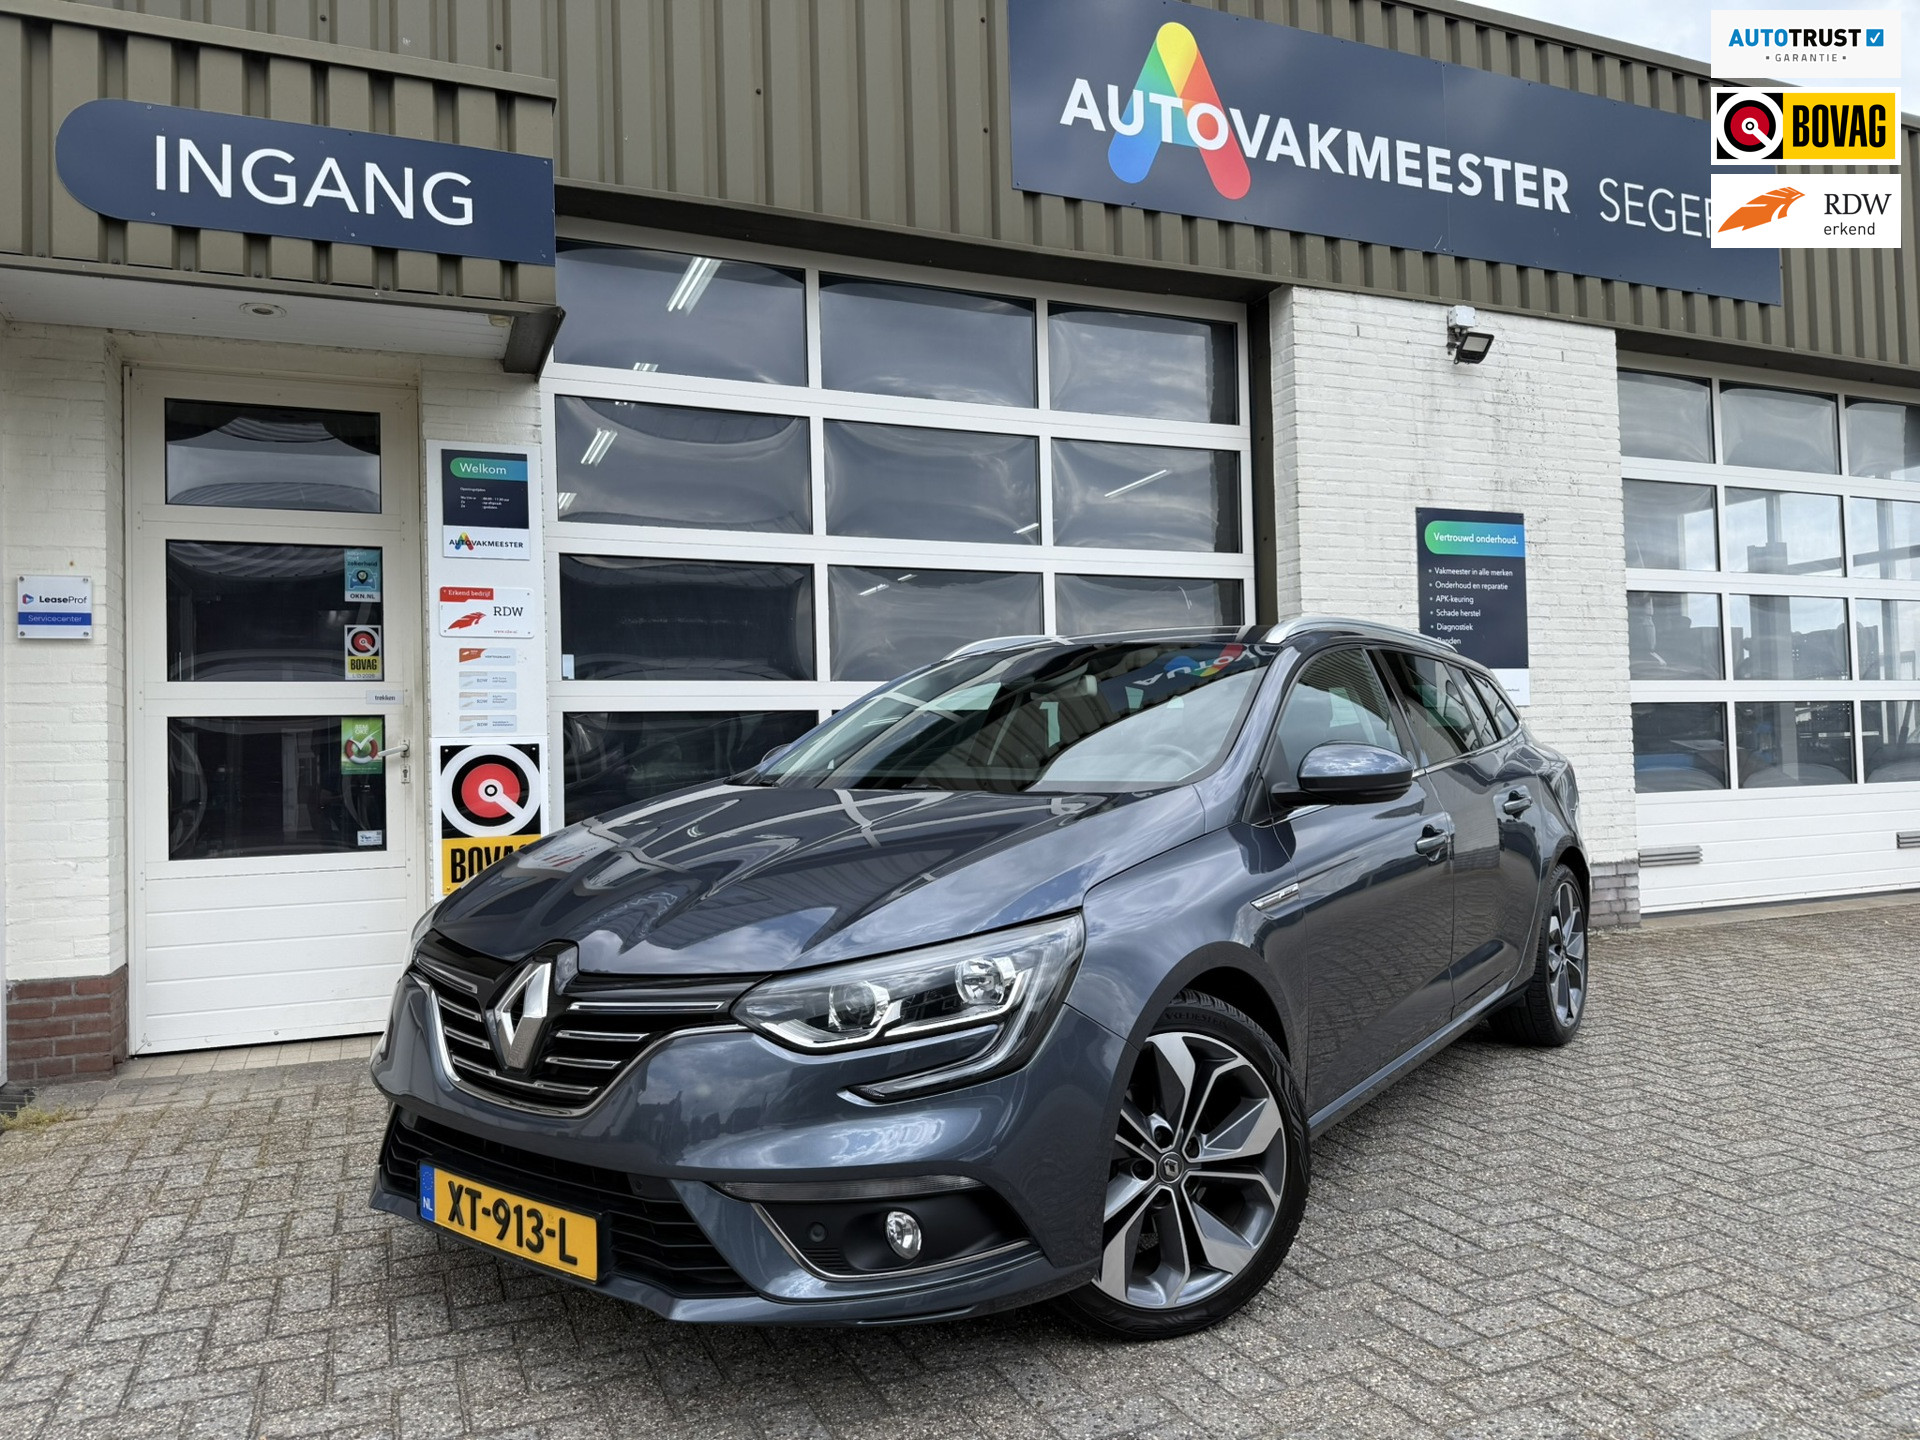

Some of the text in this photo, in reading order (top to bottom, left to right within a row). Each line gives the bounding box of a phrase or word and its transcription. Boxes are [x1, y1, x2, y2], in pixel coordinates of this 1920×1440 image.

[1060, 78, 1571, 214] AUTOVAKMEESTER
[155, 134, 474, 226] INGANG
[459, 462, 507, 475] Welkom
[1433, 532, 1519, 545] Vertrouwd onderhoud.
[1434, 567, 1513, 577] Vakmeester in alle merken
[1435, 580, 1472, 589] Onderhoud
[1481, 582, 1509, 591] reparatie
[350, 592, 376, 600] OKN.NL
[448, 589, 470, 597] Erkend
[39, 595, 88, 604] LeaseProf
[1435, 595, 1474, 605] APK-keuring
[493, 606, 524, 617] RDW
[1436, 609, 1481, 617] Schade herstel
[28, 614, 82, 623] Servicecenter
[1436, 622, 1474, 632] Diagnostiek
[350, 658, 378, 671] BOVAG
[374, 694, 396, 702] trekken
[422, 1197, 433, 1212] NL
[447, 1180, 578, 1266] XT-913-L
